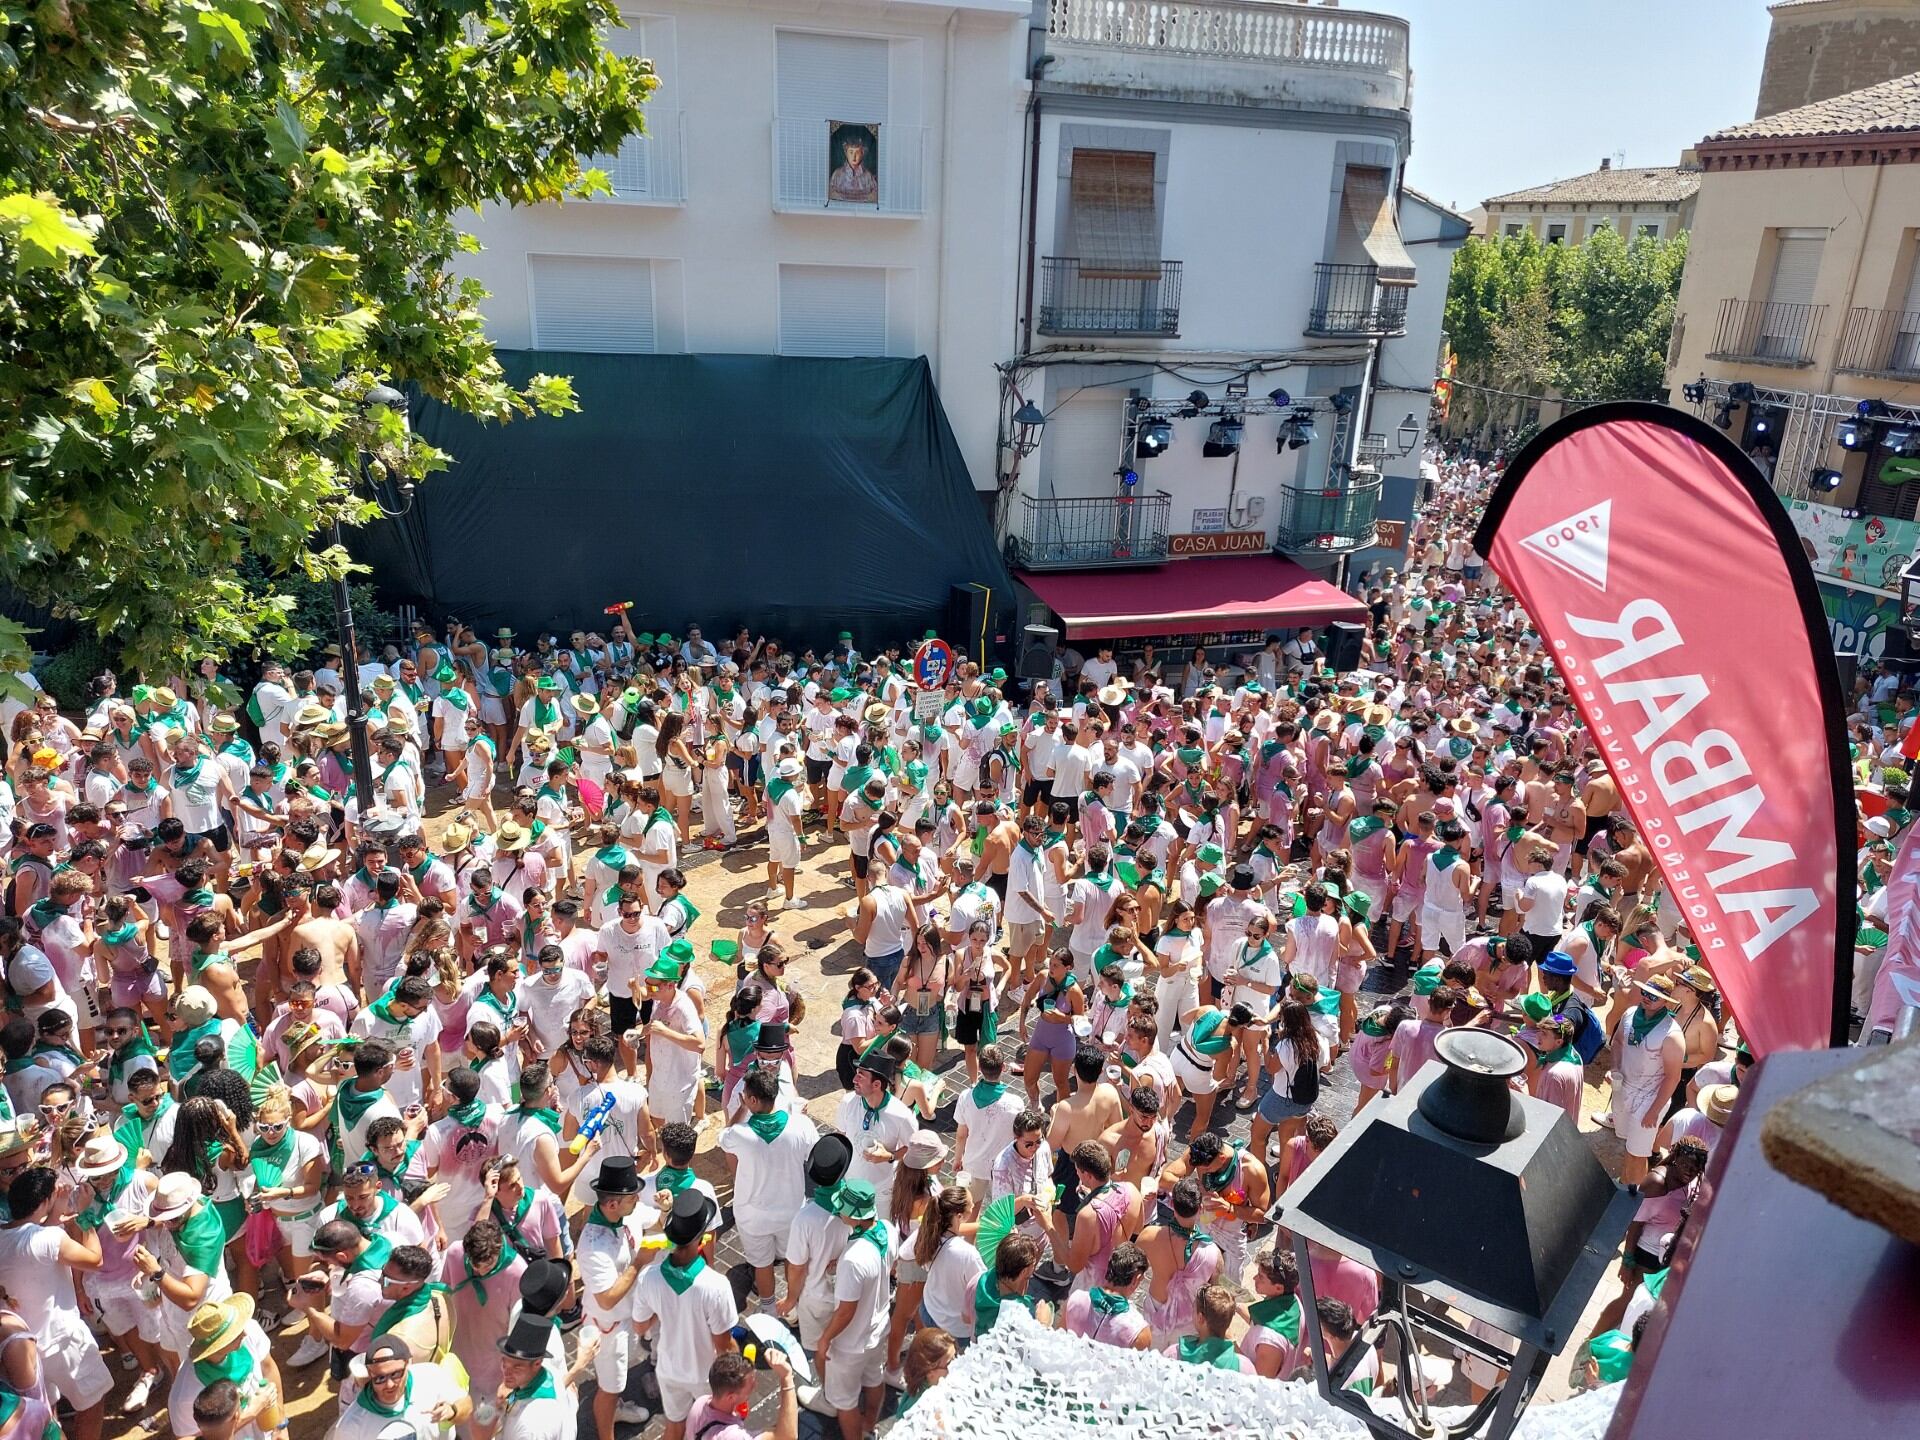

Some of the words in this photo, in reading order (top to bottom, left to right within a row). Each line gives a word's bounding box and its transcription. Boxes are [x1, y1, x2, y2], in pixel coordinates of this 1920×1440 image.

[1376, 523, 1396, 534] ASA
[1172, 536, 1217, 552] CASA
[1221, 534, 1264, 550] JUAN
